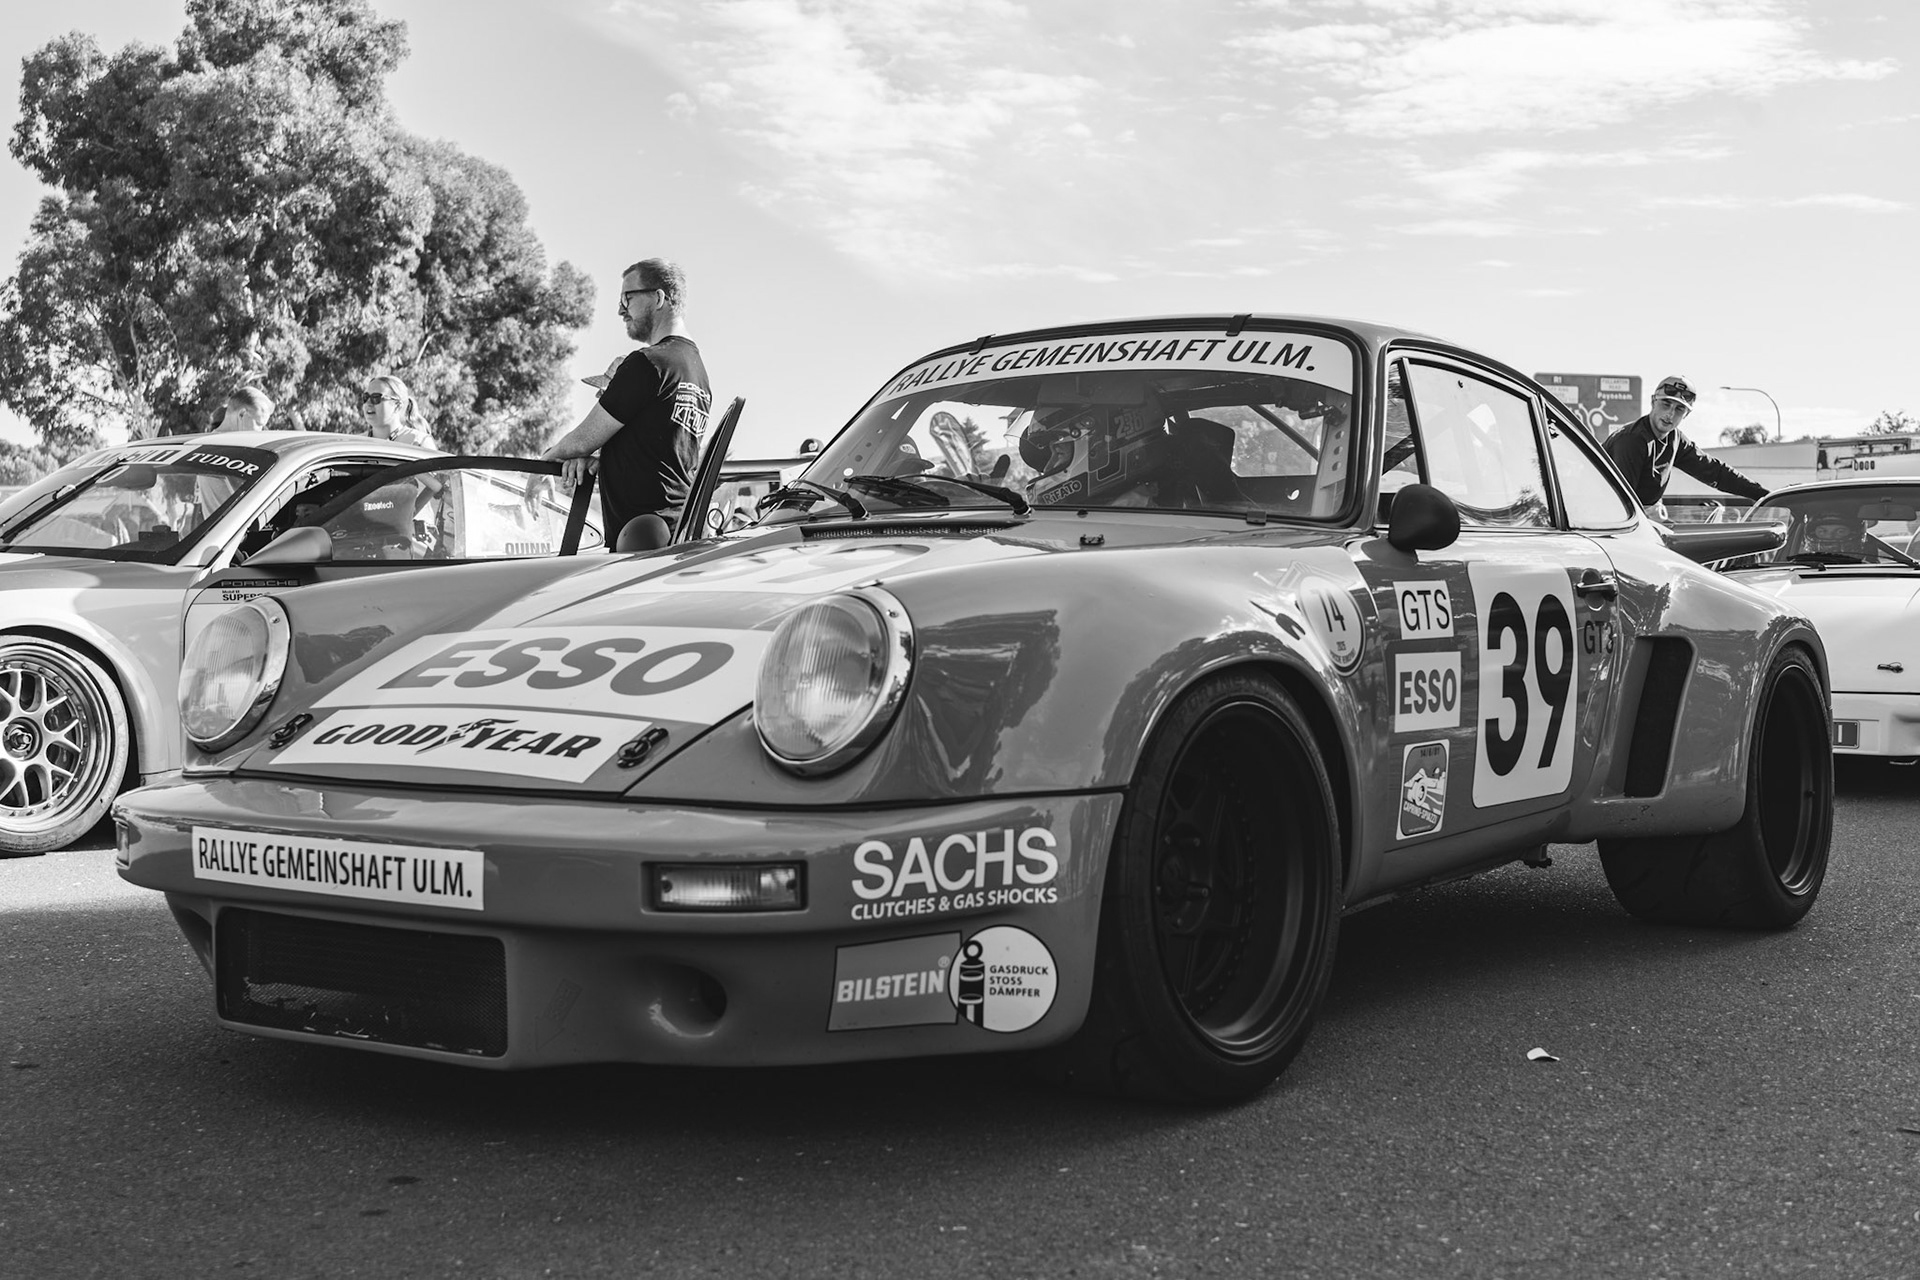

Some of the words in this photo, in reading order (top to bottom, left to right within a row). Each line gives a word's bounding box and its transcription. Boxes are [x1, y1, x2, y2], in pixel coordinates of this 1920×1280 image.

[888, 353, 993, 396] RALLYE
[990, 338, 1227, 372] GEMEINSHAFT
[1222, 339, 1316, 372] ULM.
[186, 452, 260, 476] TUDOR
[504, 542, 552, 556] QUINN
[1401, 589, 1450, 632] GTS
[377, 637, 735, 697] ESSO
[1484, 591, 1574, 777] 39
[1399, 667, 1457, 716] ESSO
[198, 837, 259, 876] RALLYE
[262, 844, 406, 892] GEMEINSHAFT
[412, 857, 473, 898] ULM.
[851, 826, 1059, 900] SACHS
[850, 897, 936, 921] CLUTCHES
[938, 895, 950, 912] &
[953, 892, 985, 910] GAS
[987, 887, 1058, 906] SHOCKS
[989, 964, 1049, 976] GASDRUCK
[989, 975, 1023, 986] STOSS
[989, 985, 1041, 998] DÄMPFER
